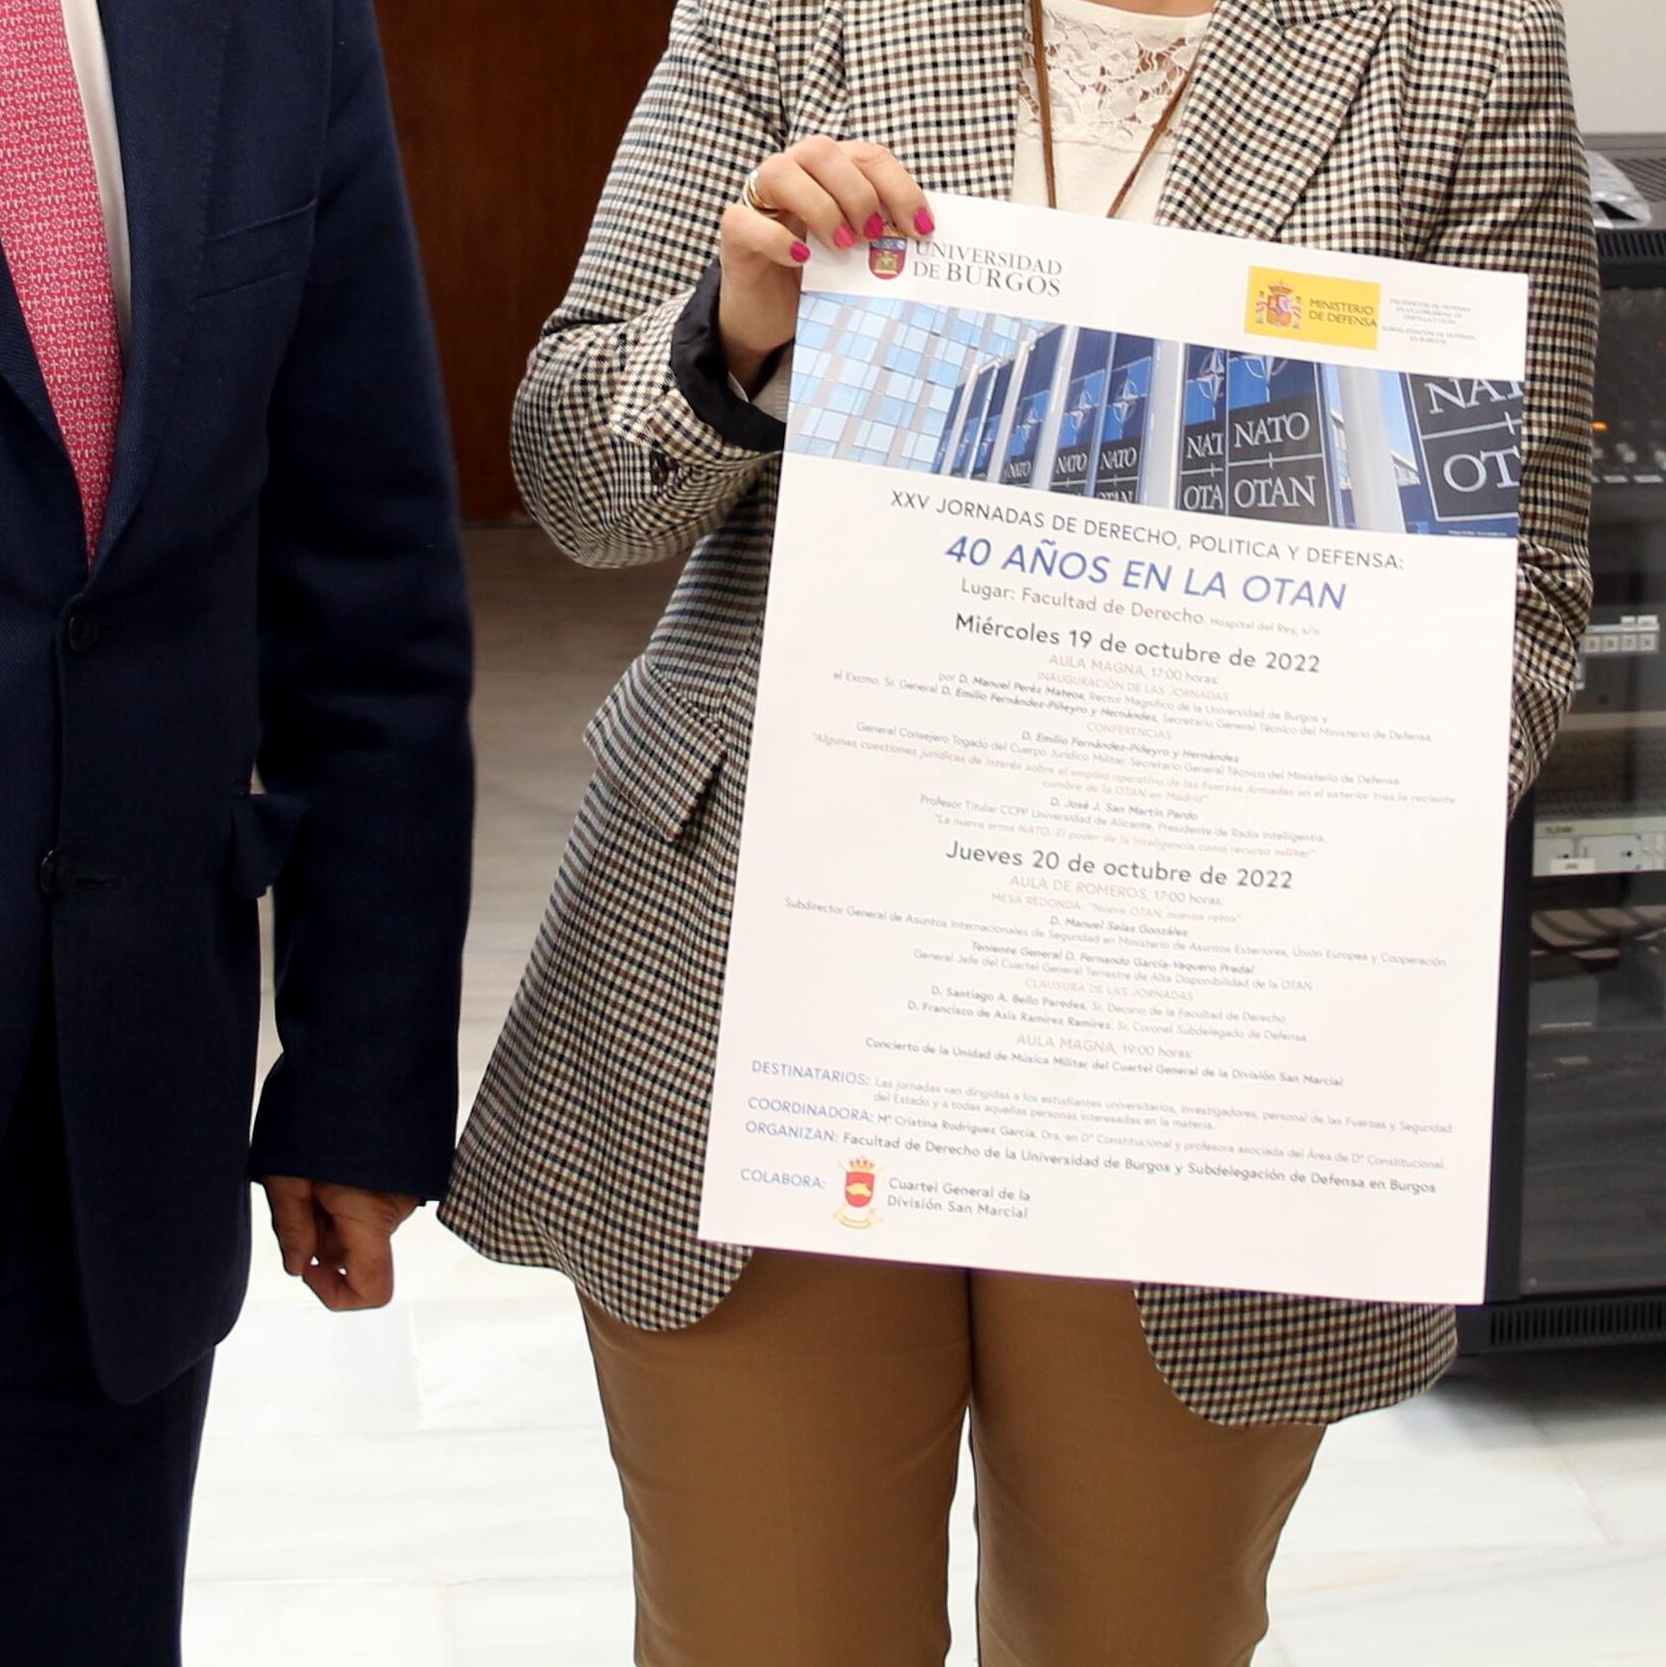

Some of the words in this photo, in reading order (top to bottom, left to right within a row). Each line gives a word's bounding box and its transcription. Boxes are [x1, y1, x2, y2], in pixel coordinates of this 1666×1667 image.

[915, 239, 1062, 276] UNIVERSIDAD
[913, 260, 941, 280] DE
[946, 261, 1061, 298] BURGOS
[1309, 297, 1374, 317] MINISTERIO
[1309, 310, 1325, 321] DE
[1326, 310, 1378, 328] DEFENSA
[1234, 411, 1310, 449] NATO
[1100, 446, 1138, 471] NATO
[1187, 433, 1225, 459] NAT
[1056, 452, 1088, 475] NATO
[1443, 445, 1521, 493] OT
[1183, 484, 1225, 511] OTA
[1234, 475, 1317, 509] OTAN
[891, 489, 929, 511] XXV
[936, 496, 1045, 529] JORNADAS
[1051, 514, 1076, 533] DE
[1083, 519, 1181, 549] DERECHO,
[1189, 533, 1279, 559] POLITICA
[1287, 545, 1298, 560] Y
[1306, 546, 1402, 569] DEFENSA:
[945, 533, 991, 567] 40
[1001, 539, 1110, 584] AÑOS
[1122, 559, 1171, 592] EN
[1184, 567, 1226, 598] LA
[1242, 573, 1345, 611] OTAN
[960, 577, 1015, 604] Lugar:
[1021, 586, 1097, 611] Facultad
[1102, 597, 1125, 614] de
[954, 612, 1060, 644] Miércoles
[1068, 628, 1092, 648] 19
[1099, 631, 1127, 653] de
[1134, 636, 1220, 664] octubre
[1228, 646, 1255, 667] de
[1265, 650, 1319, 673] 2022
[1049, 653, 1086, 669] AULA
[946, 839, 1023, 866] Jueves
[1032, 849, 1059, 870] 20
[1067, 852, 1095, 874] de
[1103, 856, 1191, 882] octubre
[1199, 864, 1227, 885] de
[1236, 867, 1292, 889] 2022
[1009, 873, 1048, 890] AULA
[1052, 878, 1071, 892] DE
[1015, 1032, 1055, 1048] AULA
[751, 1059, 868, 1086] DESTINATARIOS:
[746, 1094, 873, 1124] COORDINADORA:
[744, 1118, 838, 1142] ORGANIZAN:
[842, 1131, 900, 1149] Facultad
[904, 1137, 921, 1151] de
[924, 1139, 980, 1157] Derecho
[984, 1145, 1000, 1158] de
[1004, 1147, 1016, 1159] la
[1020, 1148, 1099, 1167] Universidad
[1103, 1155, 1120, 1168] de
[1124, 1157, 1170, 1175] Burgos
[1174, 1164, 1182, 1175] y
[1187, 1161, 1285, 1184] Subdelegación
[1289, 1169, 1306, 1183] de
[1310, 1171, 1365, 1188] Defensa
[1368, 1179, 1385, 1189] en
[1389, 1178, 1435, 1196] Burgos
[739, 1168, 825, 1189] COLABORA:
[888, 1176, 938, 1193] Cuartel
[941, 1181, 994, 1198] General
[997, 1186, 1014, 1200] de
[1018, 1189, 1030, 1201] la
[886, 1194, 942, 1210] División
[947, 1200, 972, 1213] San
[976, 1202, 1027, 1218] Marcial
